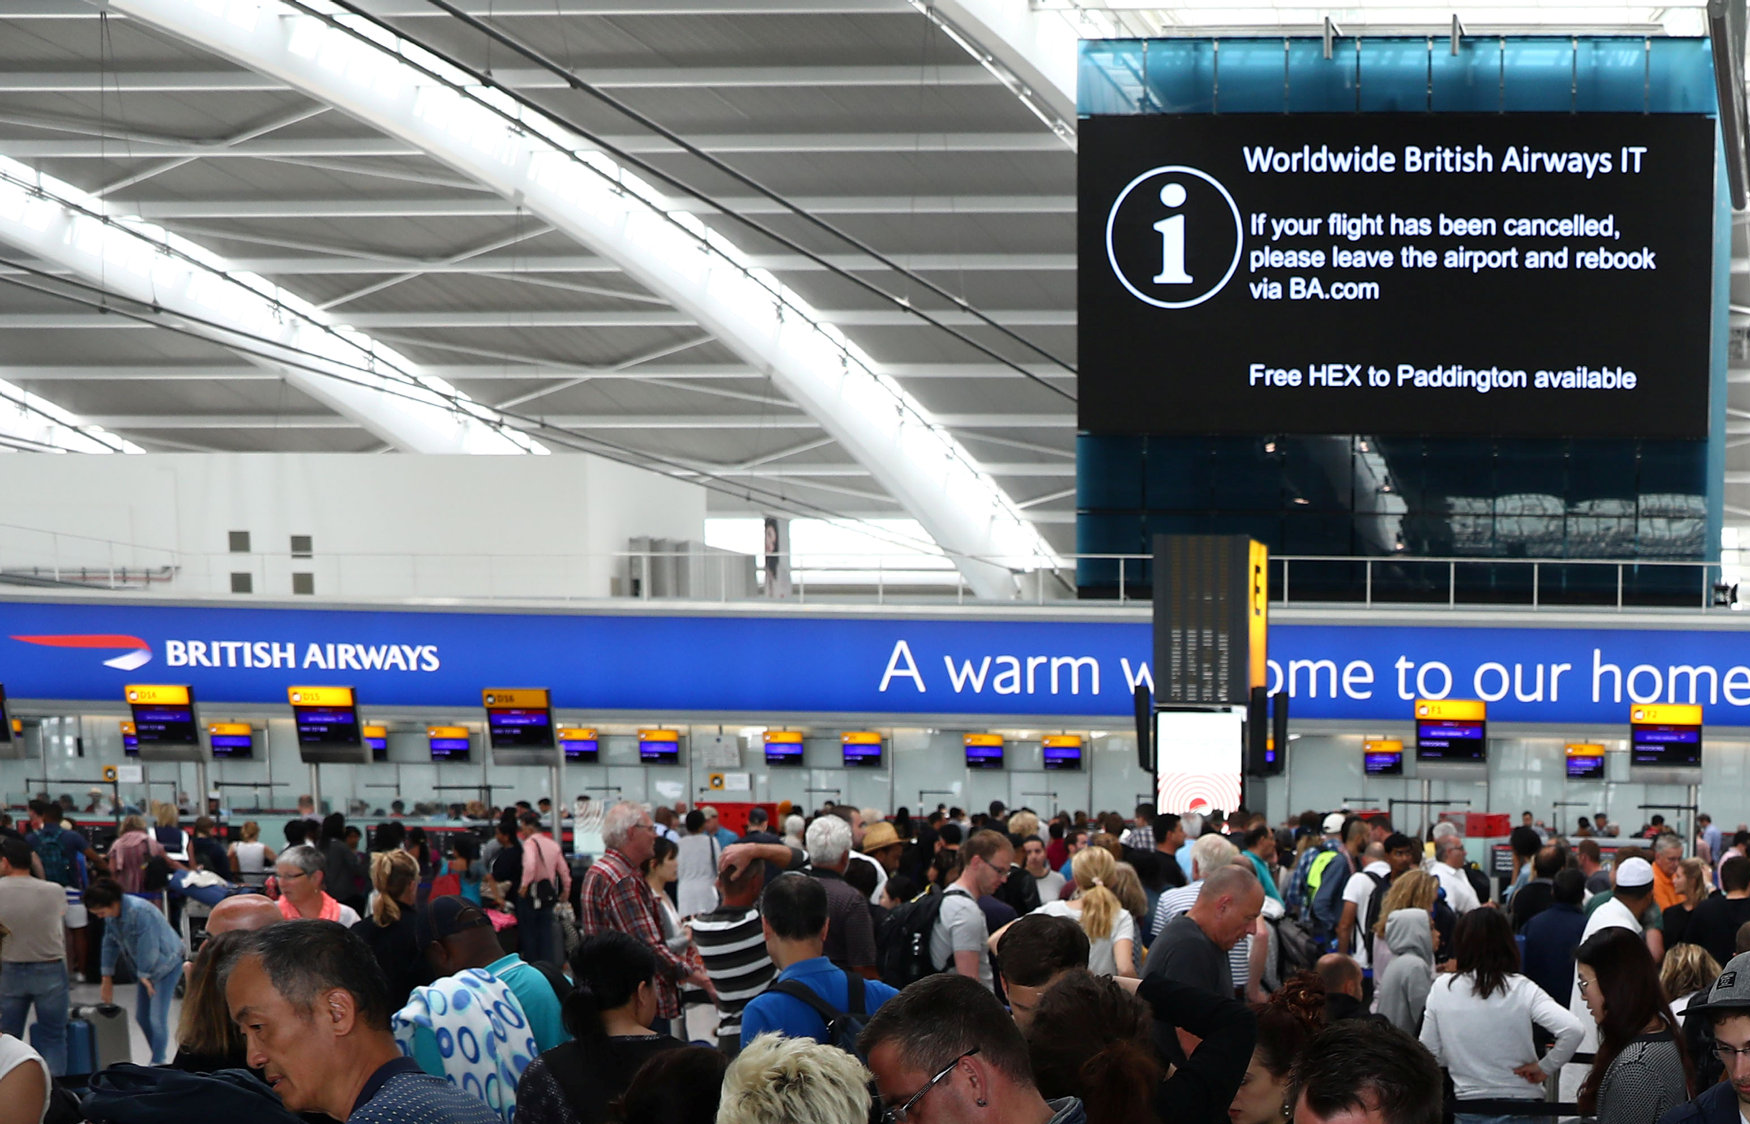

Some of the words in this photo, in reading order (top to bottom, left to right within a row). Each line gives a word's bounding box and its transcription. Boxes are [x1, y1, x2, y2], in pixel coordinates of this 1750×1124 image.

[1242, 144, 1396, 173] Worldwide
[1405, 144, 1493, 173] British
[1501, 145, 1613, 180] Airways
[1621, 146, 1648, 173] IT
[1250, 212, 1266, 236] If
[1271, 217, 1323, 241] your
[1327, 212, 1384, 241] flight
[1390, 213, 1433, 236] has
[1439, 213, 1497, 236] been
[1503, 213, 1621, 240] cancelled,
[1250, 245, 1326, 273] please
[1332, 245, 1394, 268] leave
[1400, 245, 1438, 268] the
[1443, 245, 1519, 273] airport
[1524, 246, 1569, 269] and
[1575, 246, 1657, 270] rebook
[1249, 277, 1283, 300] via
[1289, 276, 1380, 300] BA.com
[1249, 363, 1303, 387] Free
[1309, 363, 1362, 387] HEX
[1367, 365, 1391, 387] to
[1397, 364, 1527, 393] Paddington
[1534, 365, 1637, 390] available
[166, 640, 296, 669] BRITISH
[303, 643, 440, 672] AIRWAYS
[879, 640, 926, 693] A
[944, 655, 1100, 695] warm
[1120, 648, 1374, 701] wome
[1394, 655, 1453, 702] to
[1473, 662, 1572, 703] our
